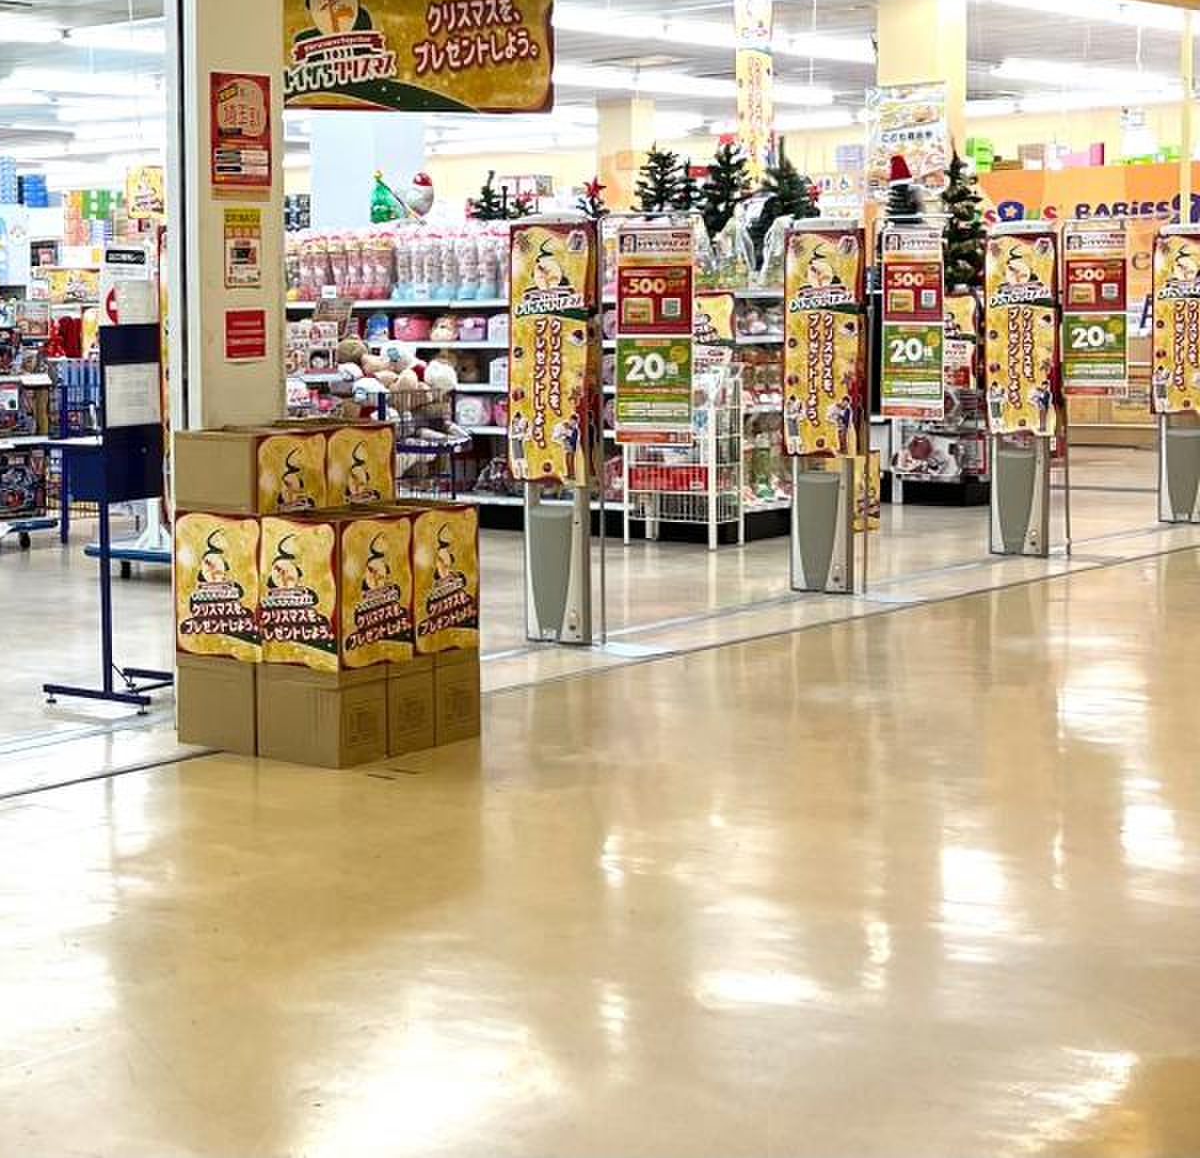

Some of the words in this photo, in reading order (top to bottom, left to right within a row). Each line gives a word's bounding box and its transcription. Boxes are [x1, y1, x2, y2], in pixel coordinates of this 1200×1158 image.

[414, 29, 539, 71] プレゼントしよう。
[549, 318, 562, 417] クリスマスを、
[533, 318, 548, 450] プレゼントしよう。
[191, 602, 248, 617] クリスマスを、
[261, 608, 323, 624] クリスマスを、
[184, 618, 259, 634] プレゼントしよう。
